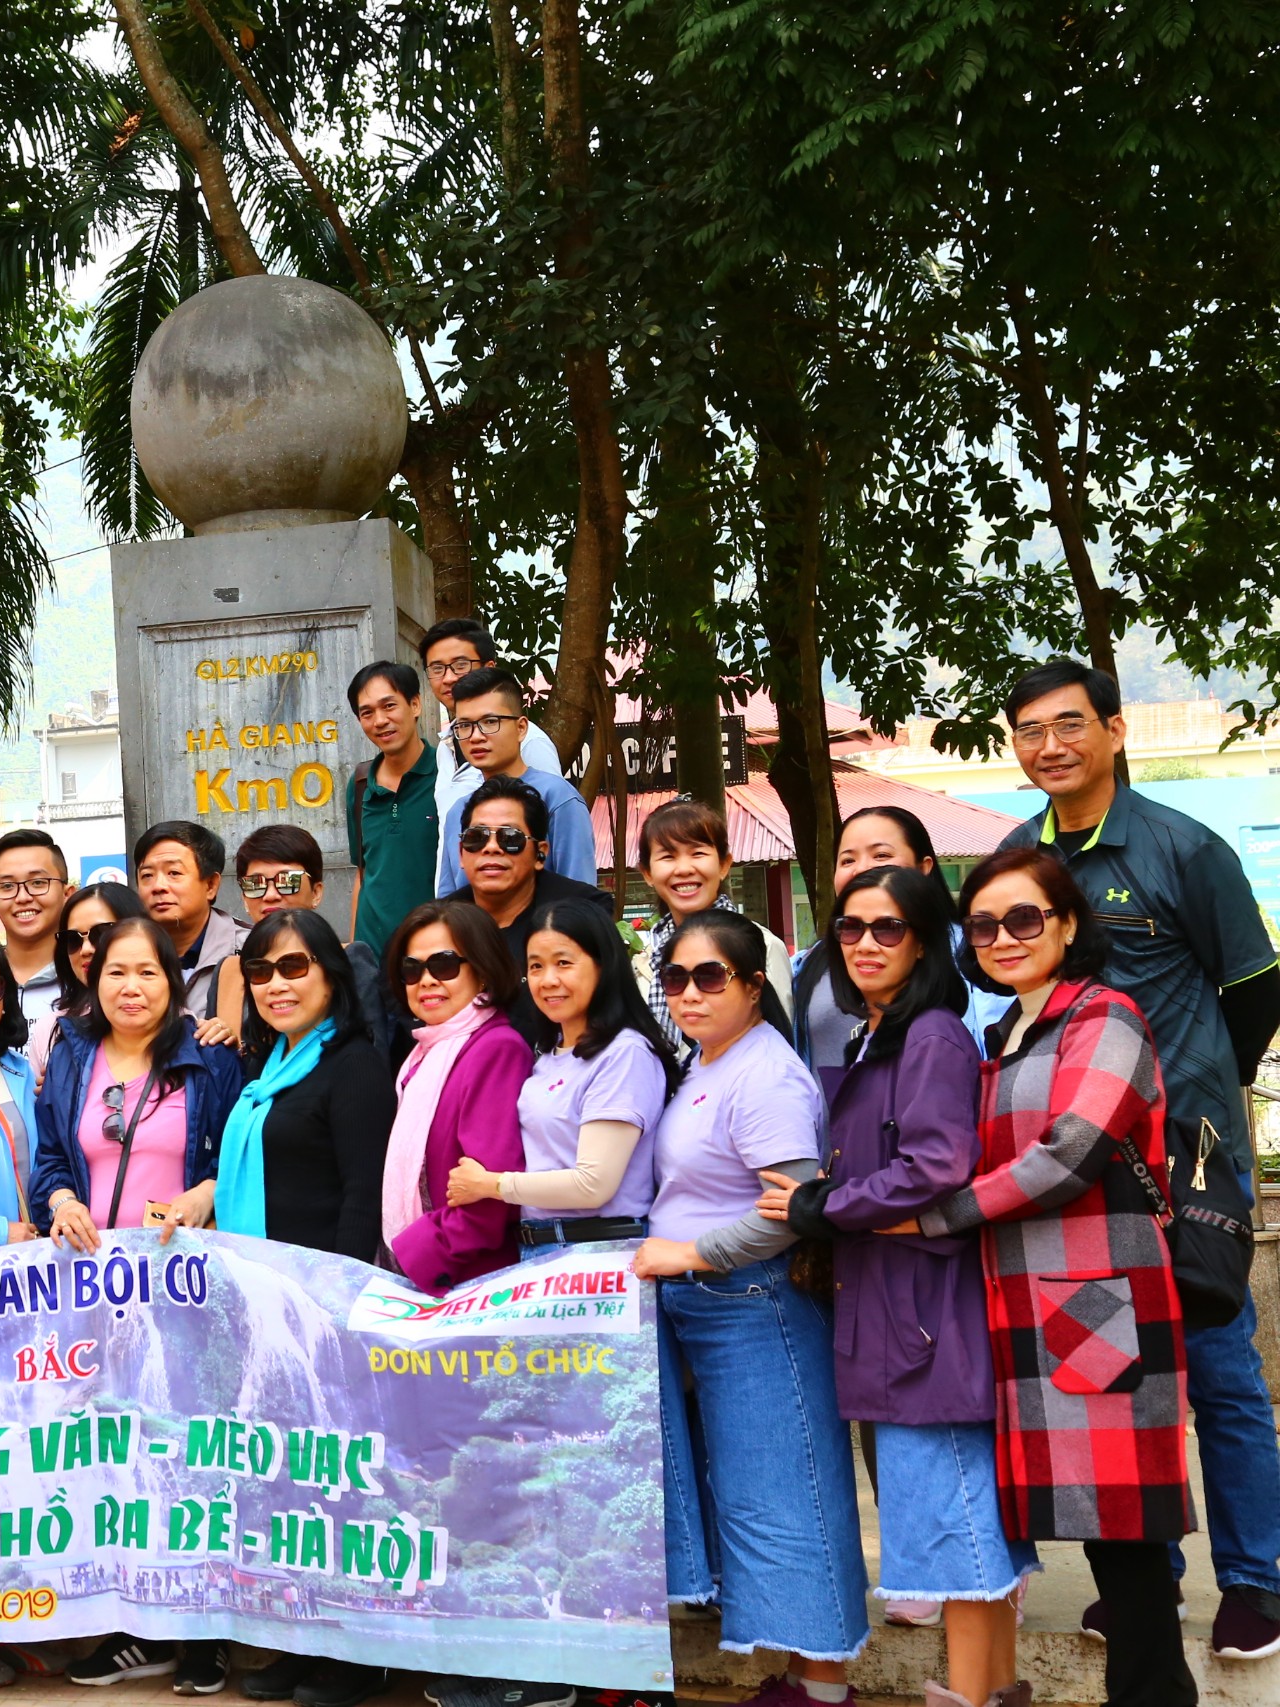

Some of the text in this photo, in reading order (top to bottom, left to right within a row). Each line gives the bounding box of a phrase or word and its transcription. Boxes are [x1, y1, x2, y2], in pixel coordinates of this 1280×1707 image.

[196, 650, 319, 681] QL2 KM290
[186, 719, 339, 752] HÀ GIANG
[74, 1246, 151, 1319] BỘI
[164, 1252, 211, 1307] CƠ
[542, 1270, 627, 1297] TRAVEL
[523, 1304, 547, 1319] Du
[551, 1301, 587, 1321] Lịch
[15, 1333, 99, 1383] BẮC
[368, 1340, 616, 1384] ĐƠN VỊ TỔ CHỨC
[28, 1411, 131, 1474] VĂN
[186, 1412, 277, 1478] MÈO
[287, 1429, 374, 1496] VẠC
[0, 1487, 73, 1557] HỒ
[94, 1494, 150, 1550] BA
[167, 1480, 232, 1552] BỂ
[271, 1505, 327, 1570] HÀ
[342, 1515, 435, 1591] NỘI
